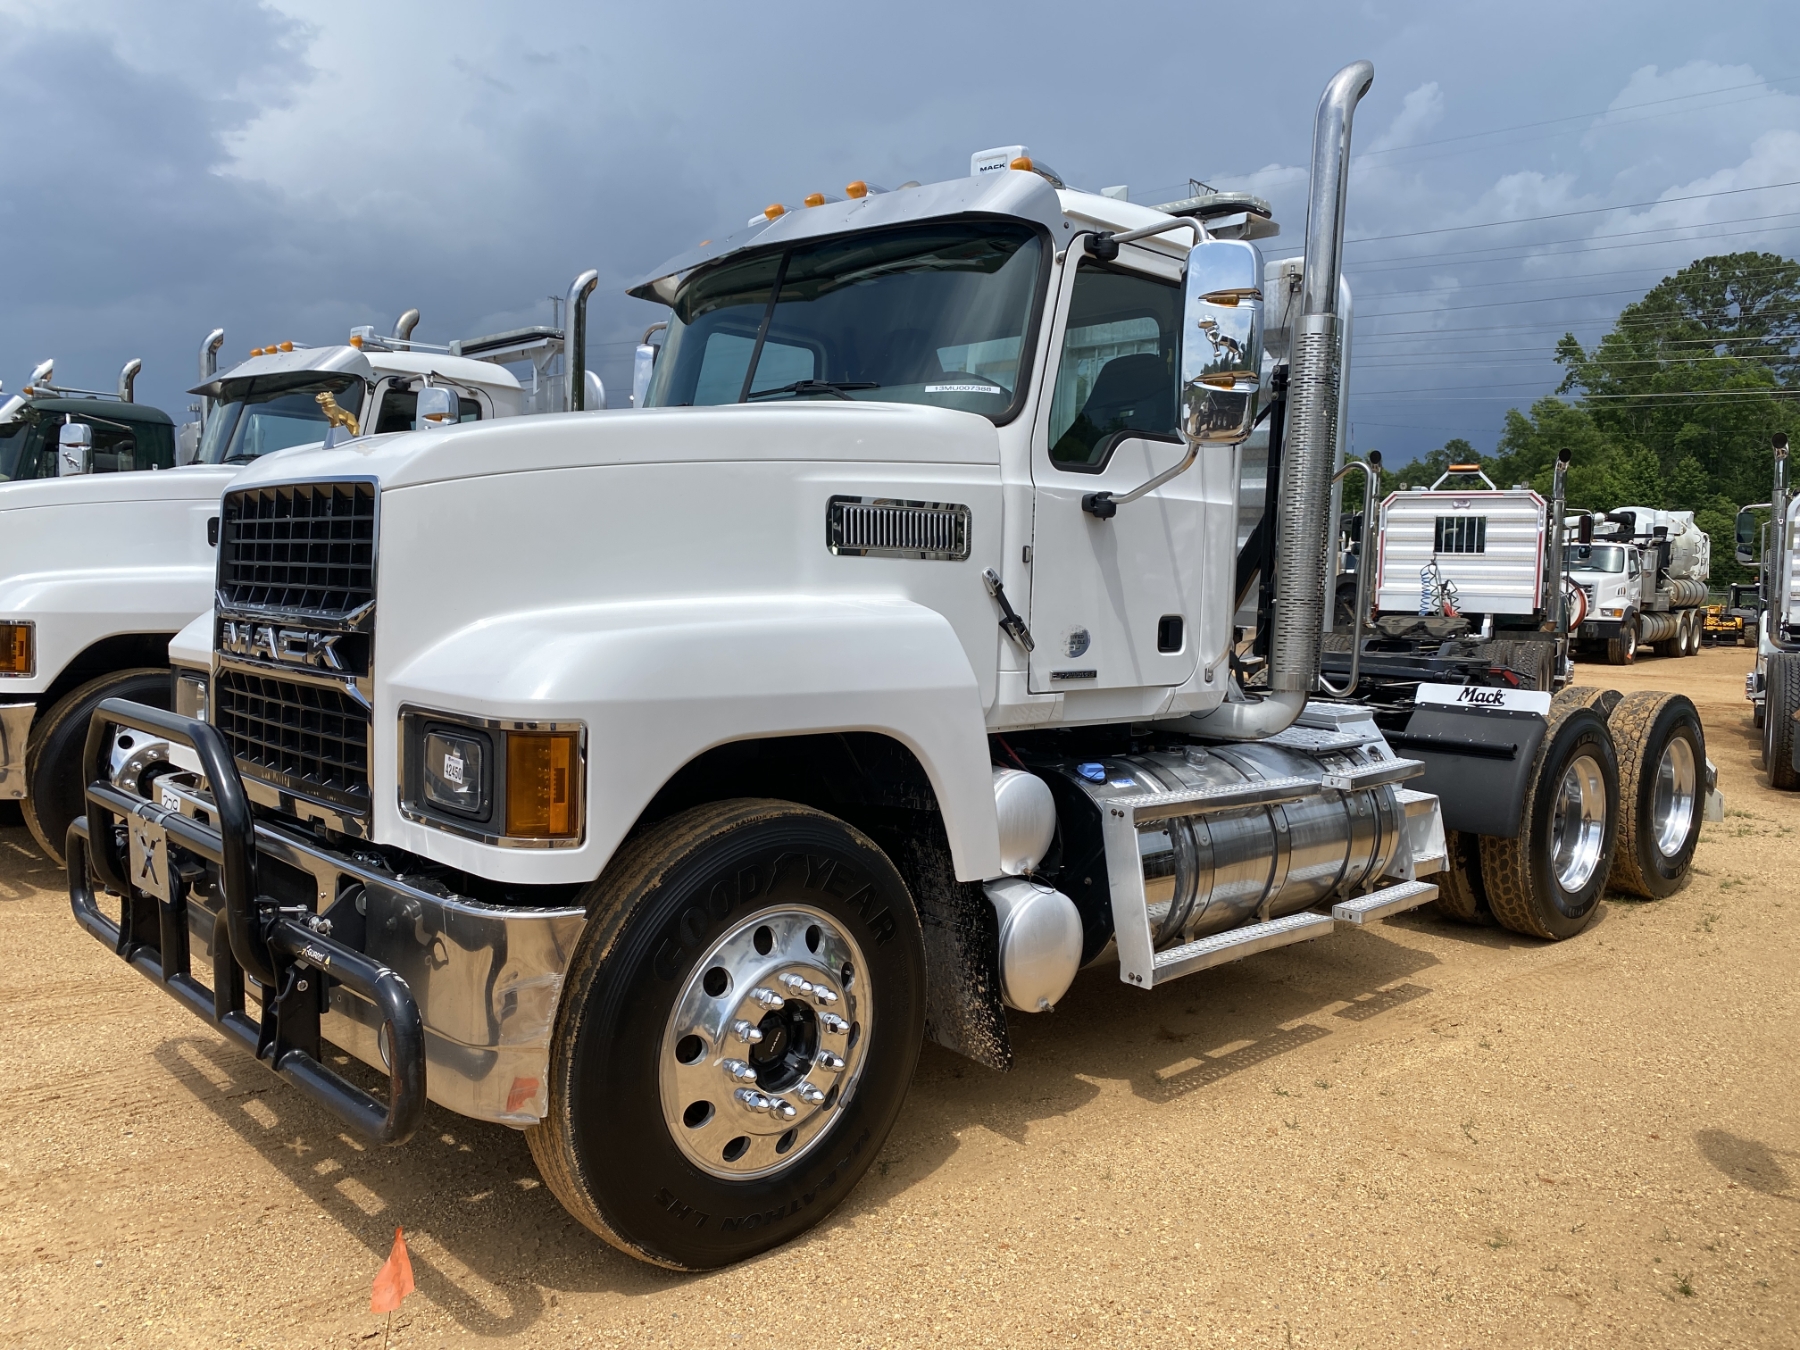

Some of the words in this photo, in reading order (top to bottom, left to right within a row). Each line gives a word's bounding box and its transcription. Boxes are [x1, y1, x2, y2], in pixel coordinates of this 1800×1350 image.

[980, 163, 1005, 171] MACK
[222, 622, 342, 669] MACK
[1456, 687, 1505, 706] Mack
[653, 1186, 711, 1230] LHS
